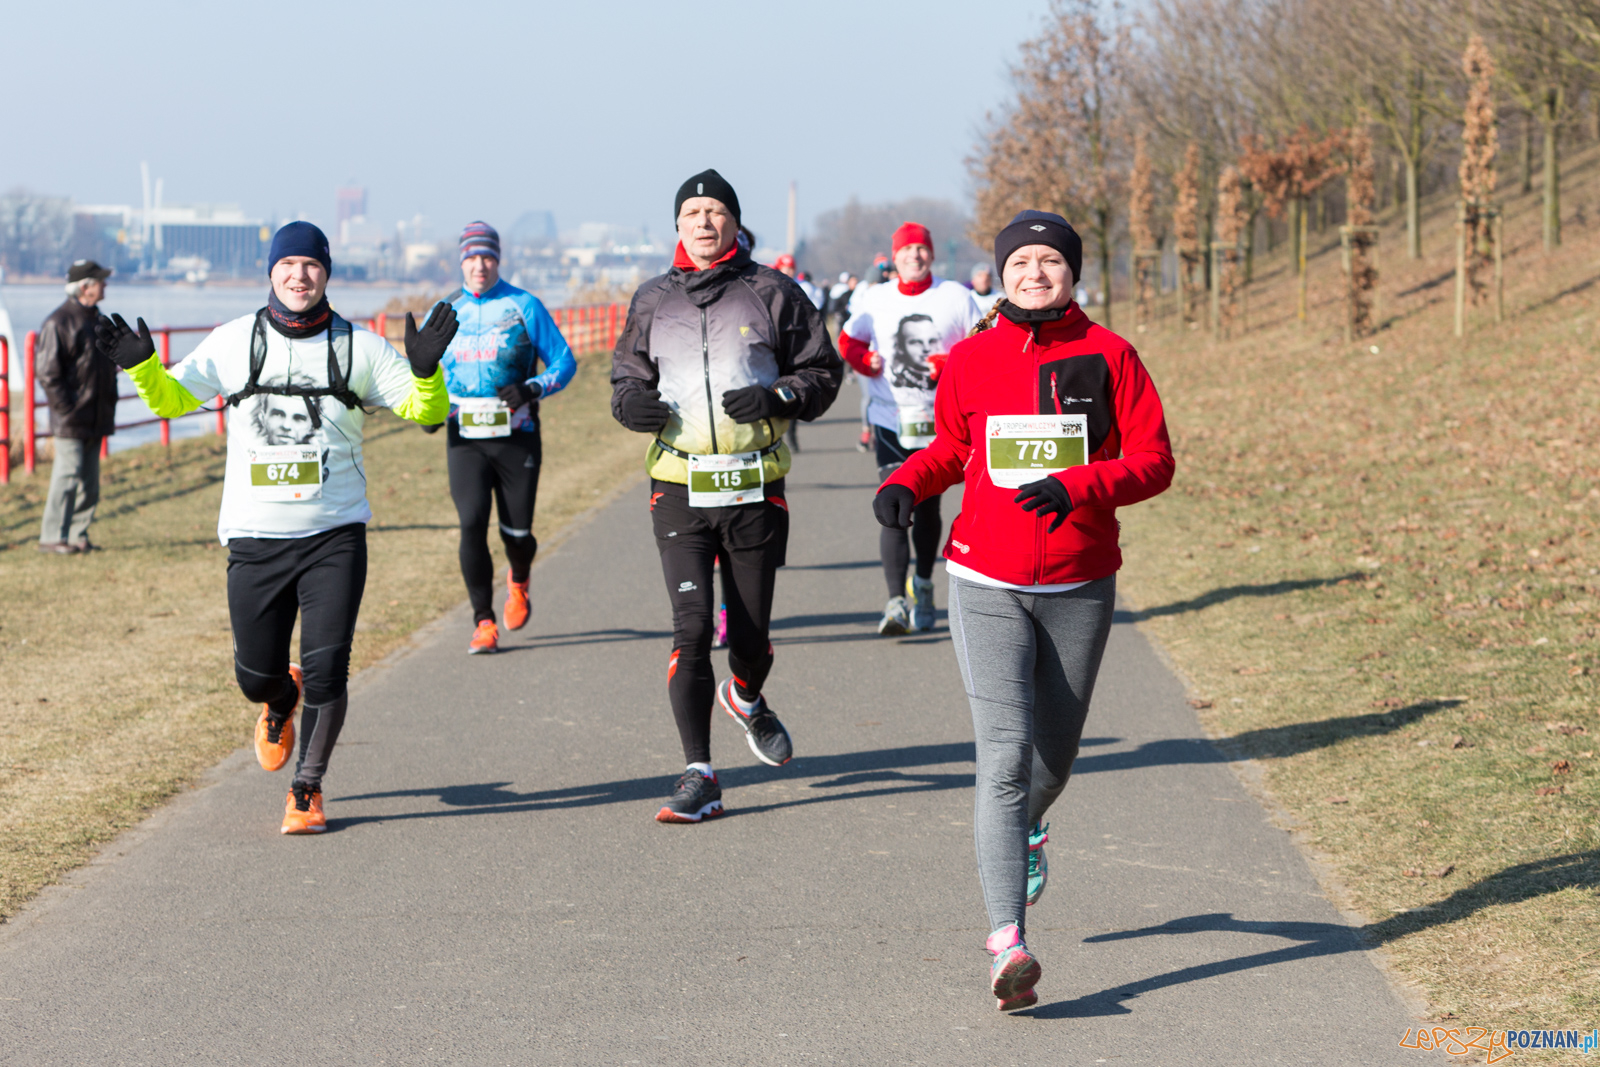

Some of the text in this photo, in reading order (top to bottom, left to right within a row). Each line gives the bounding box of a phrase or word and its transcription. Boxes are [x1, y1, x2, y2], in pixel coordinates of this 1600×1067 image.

[454, 349, 497, 362] TEAM
[1015, 440, 1058, 460] 779
[266, 463, 300, 480] 674
[711, 471, 742, 488] 115
